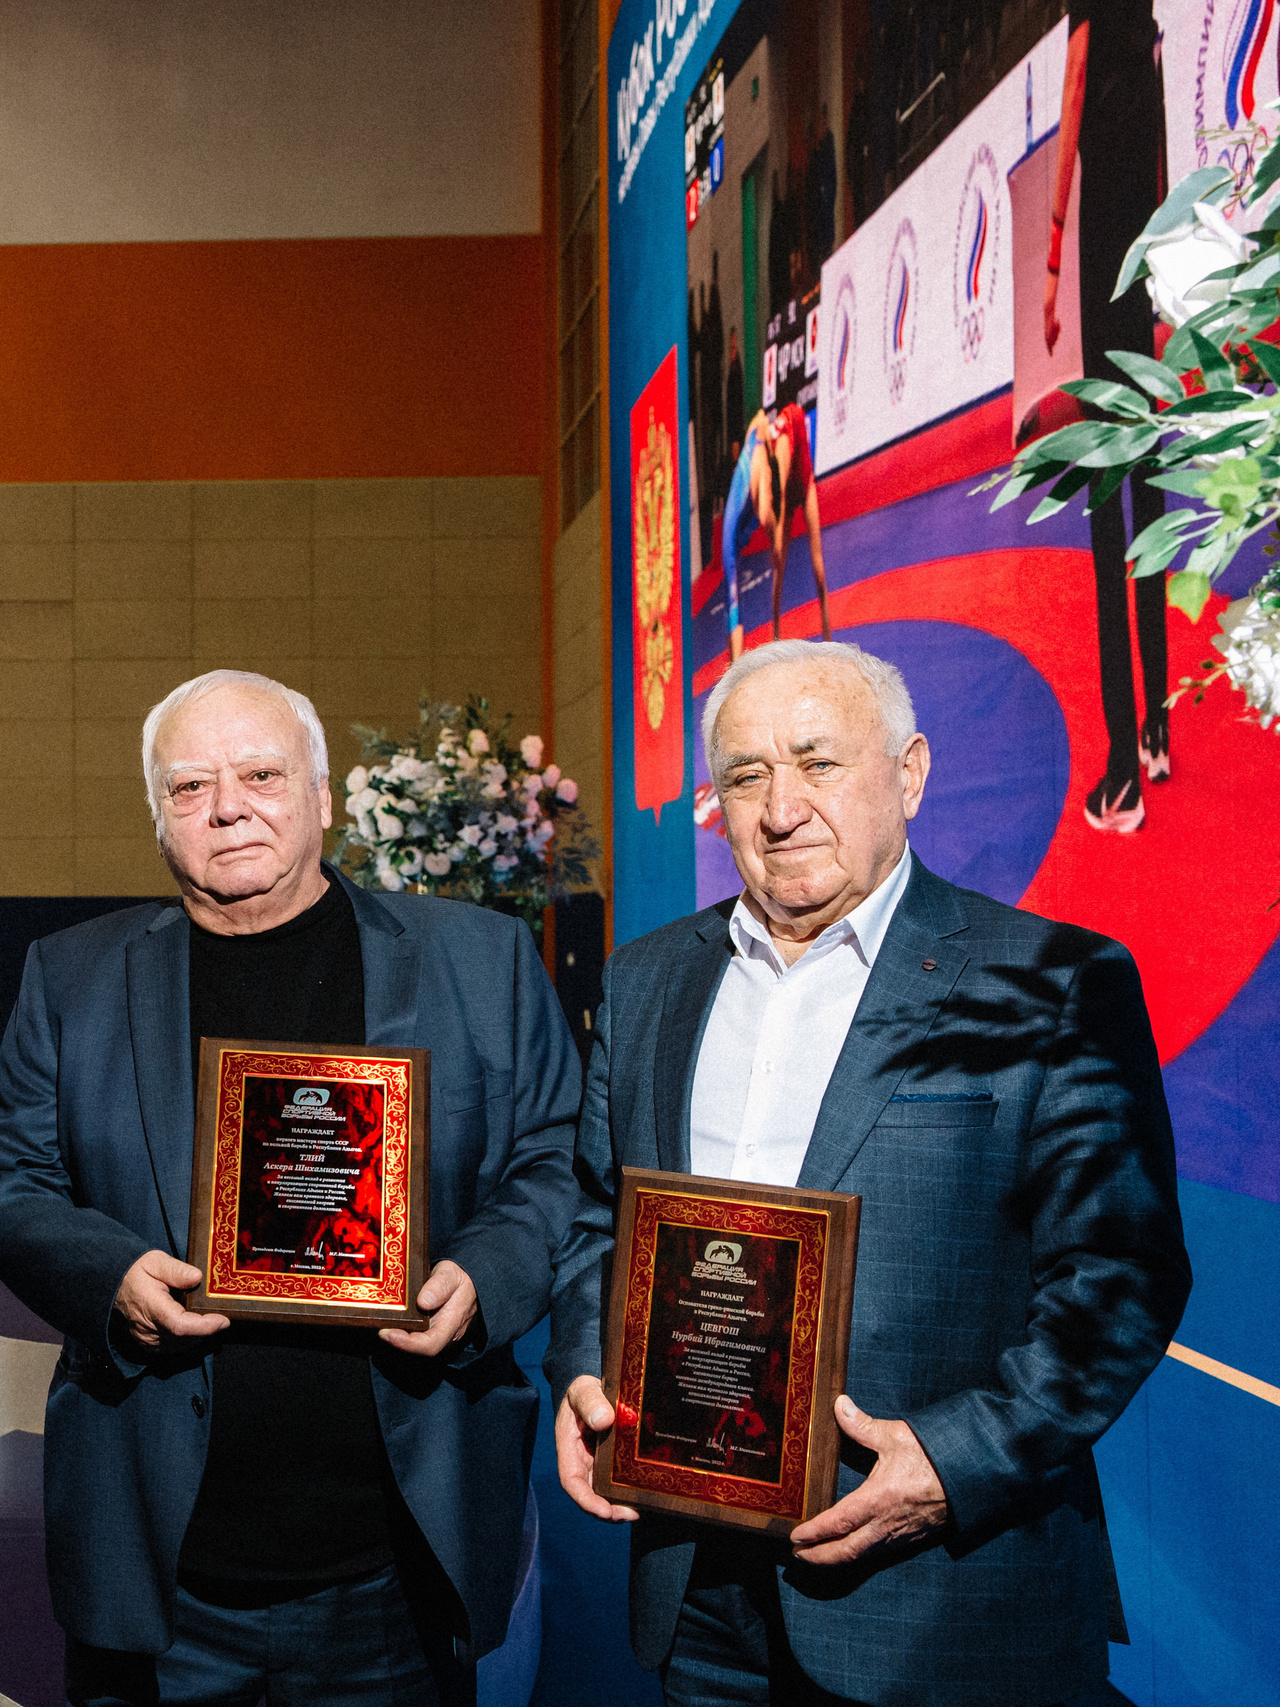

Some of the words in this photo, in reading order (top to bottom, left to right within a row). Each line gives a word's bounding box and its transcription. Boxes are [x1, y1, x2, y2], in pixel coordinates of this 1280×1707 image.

[292, 1128, 334, 1136] НАГРАЖДАЕТ
[300, 1153, 325, 1162] ТЛИЙ
[264, 1163, 293, 1172] Аскера
[693, 1266, 747, 1278] СПОРТИВНОЙ
[695, 1261, 745, 1273] ФЕДЕРАЦИЯ
[692, 1272, 723, 1281] БОРЬБЫ
[724, 1276, 757, 1286] РОССИИ
[701, 1290, 744, 1303] НАГРАЖДАЕТ
[700, 1322, 739, 1337] ЦЕВГОШ
[672, 1330, 703, 1345] Нурбий
[704, 1336, 766, 1356] Ибрагимовича
